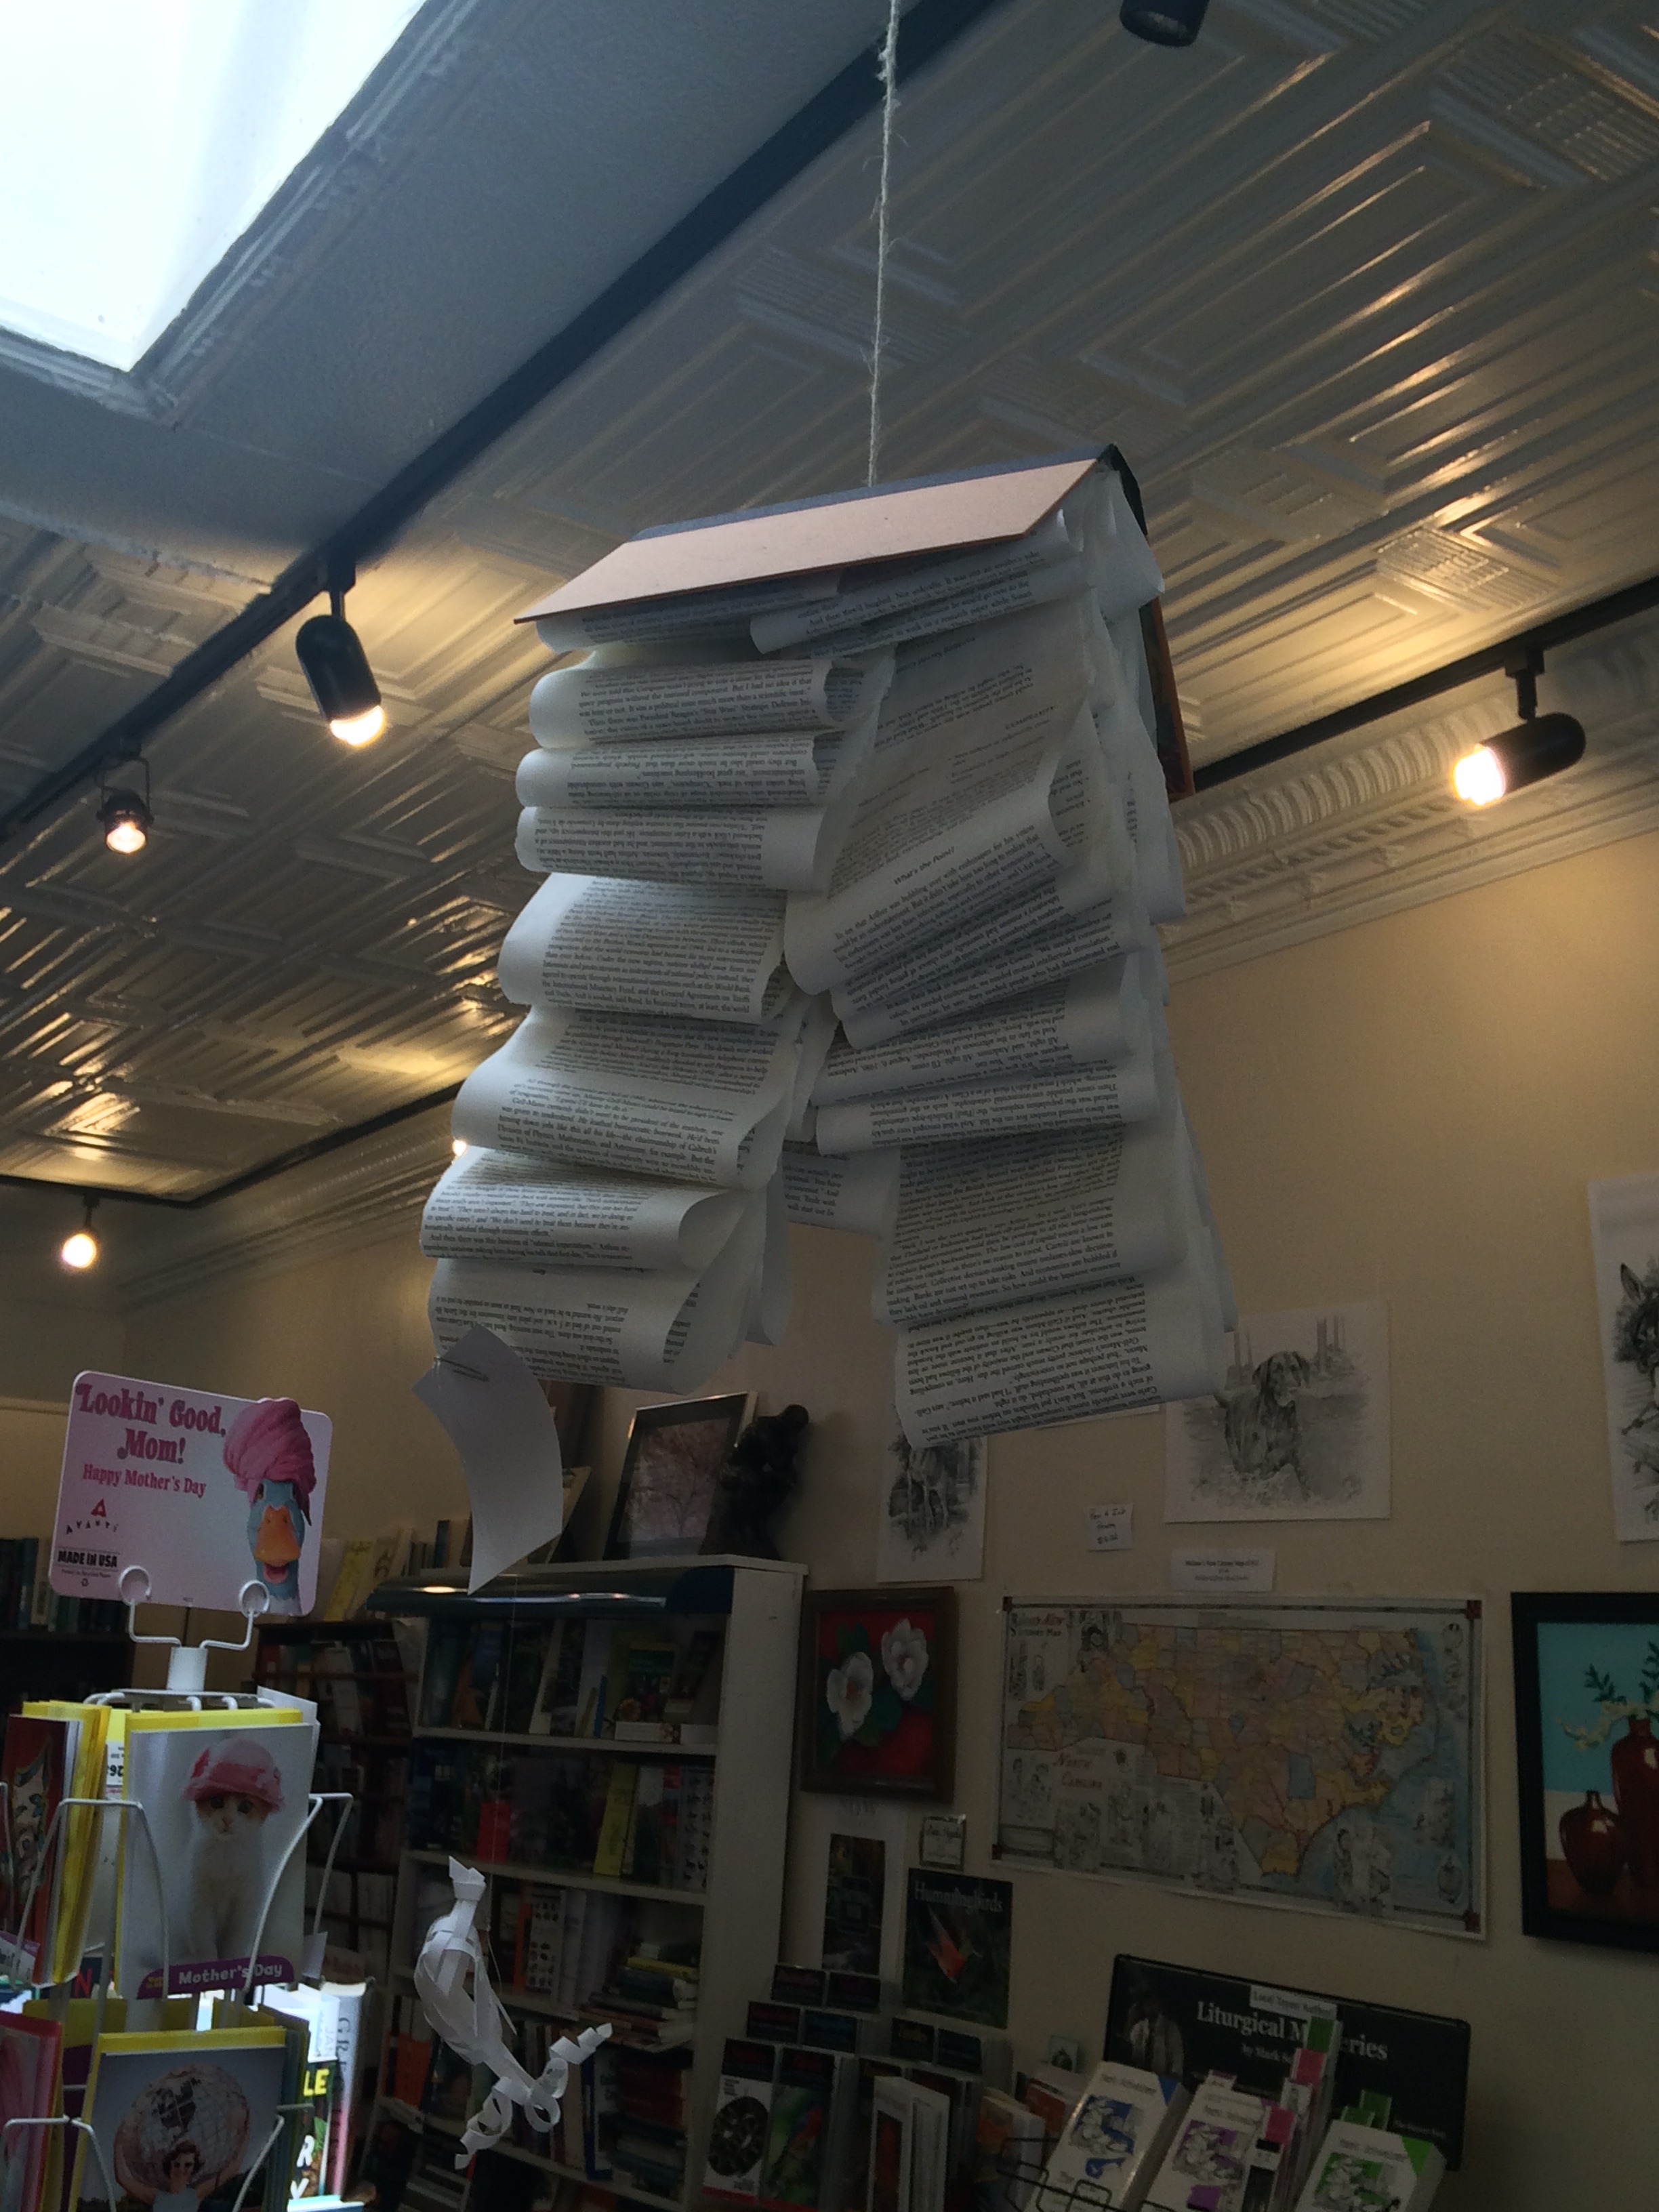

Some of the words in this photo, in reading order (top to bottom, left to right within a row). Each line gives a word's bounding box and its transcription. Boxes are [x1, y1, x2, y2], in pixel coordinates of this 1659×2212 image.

[75, 1383, 164, 1425] Lookin'
[117, 1428, 186, 1464] Mom!
[83, 1464, 122, 1488] Happy
[125, 1469, 180, 1492] Mother's
[184, 1477, 206, 1498] Day
[58, 1551, 85, 1565] MADE
[87, 1553, 97, 1567] IN
[98, 1555, 118, 1568] USA
[179, 1965, 250, 1985] Mother's
[255, 1963, 283, 1978] Day
[1197, 2000, 1285, 2039] Liturgical
